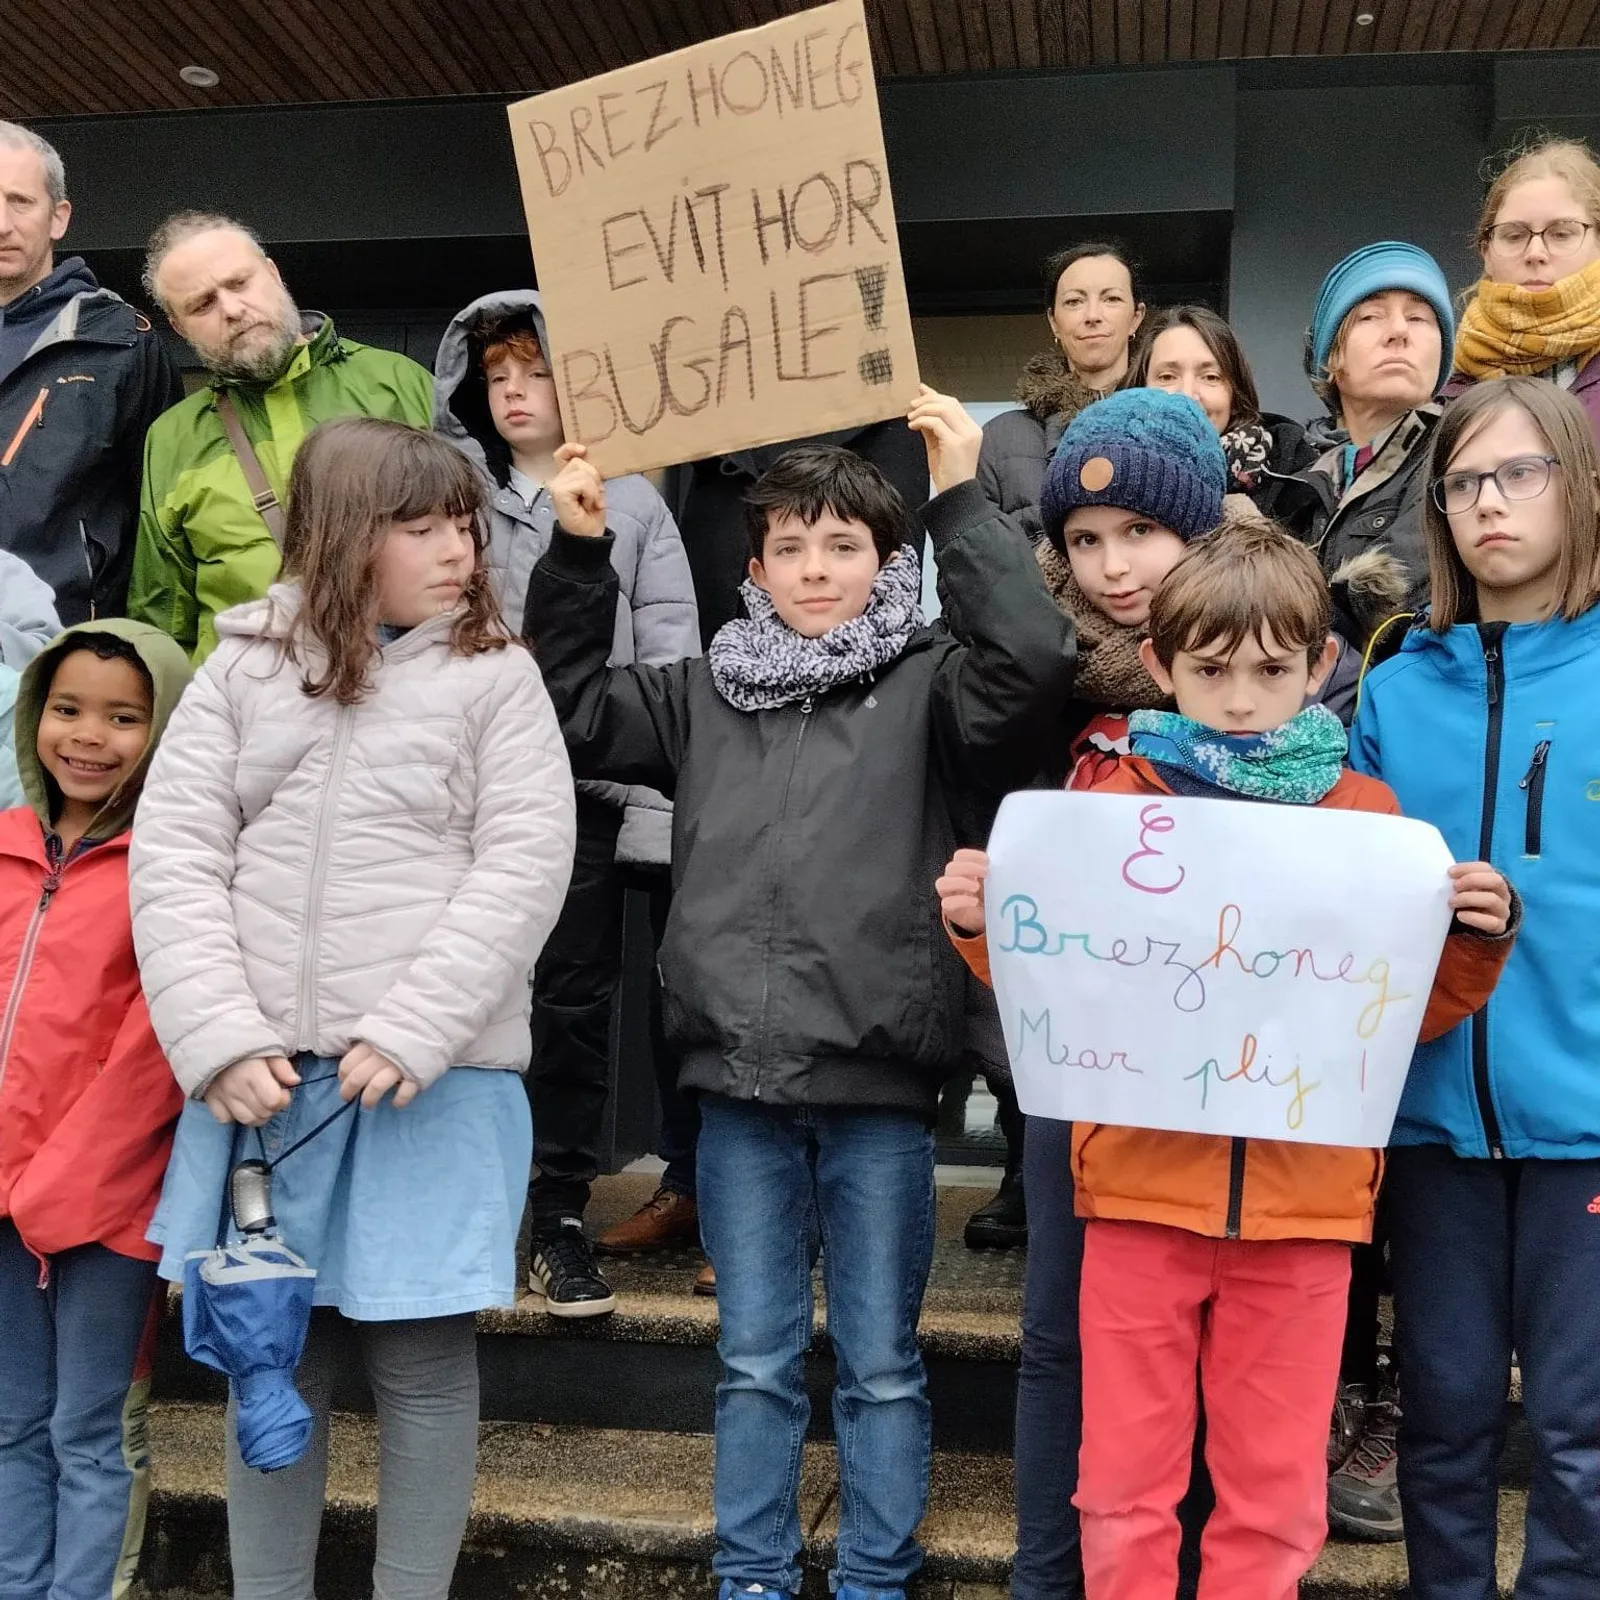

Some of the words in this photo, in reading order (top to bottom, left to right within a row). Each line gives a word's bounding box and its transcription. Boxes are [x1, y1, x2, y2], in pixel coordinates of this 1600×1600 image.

[529, 22, 864, 197] BREZHONEG
[751, 158, 888, 265] HOR
[562, 262, 895, 443] BUGALE!
[1121, 803, 1186, 894] E
[999, 893, 1412, 1039] Brezhoneg
[1013, 1008, 1144, 1076] Mar
[1183, 1034, 1323, 1130] plij
